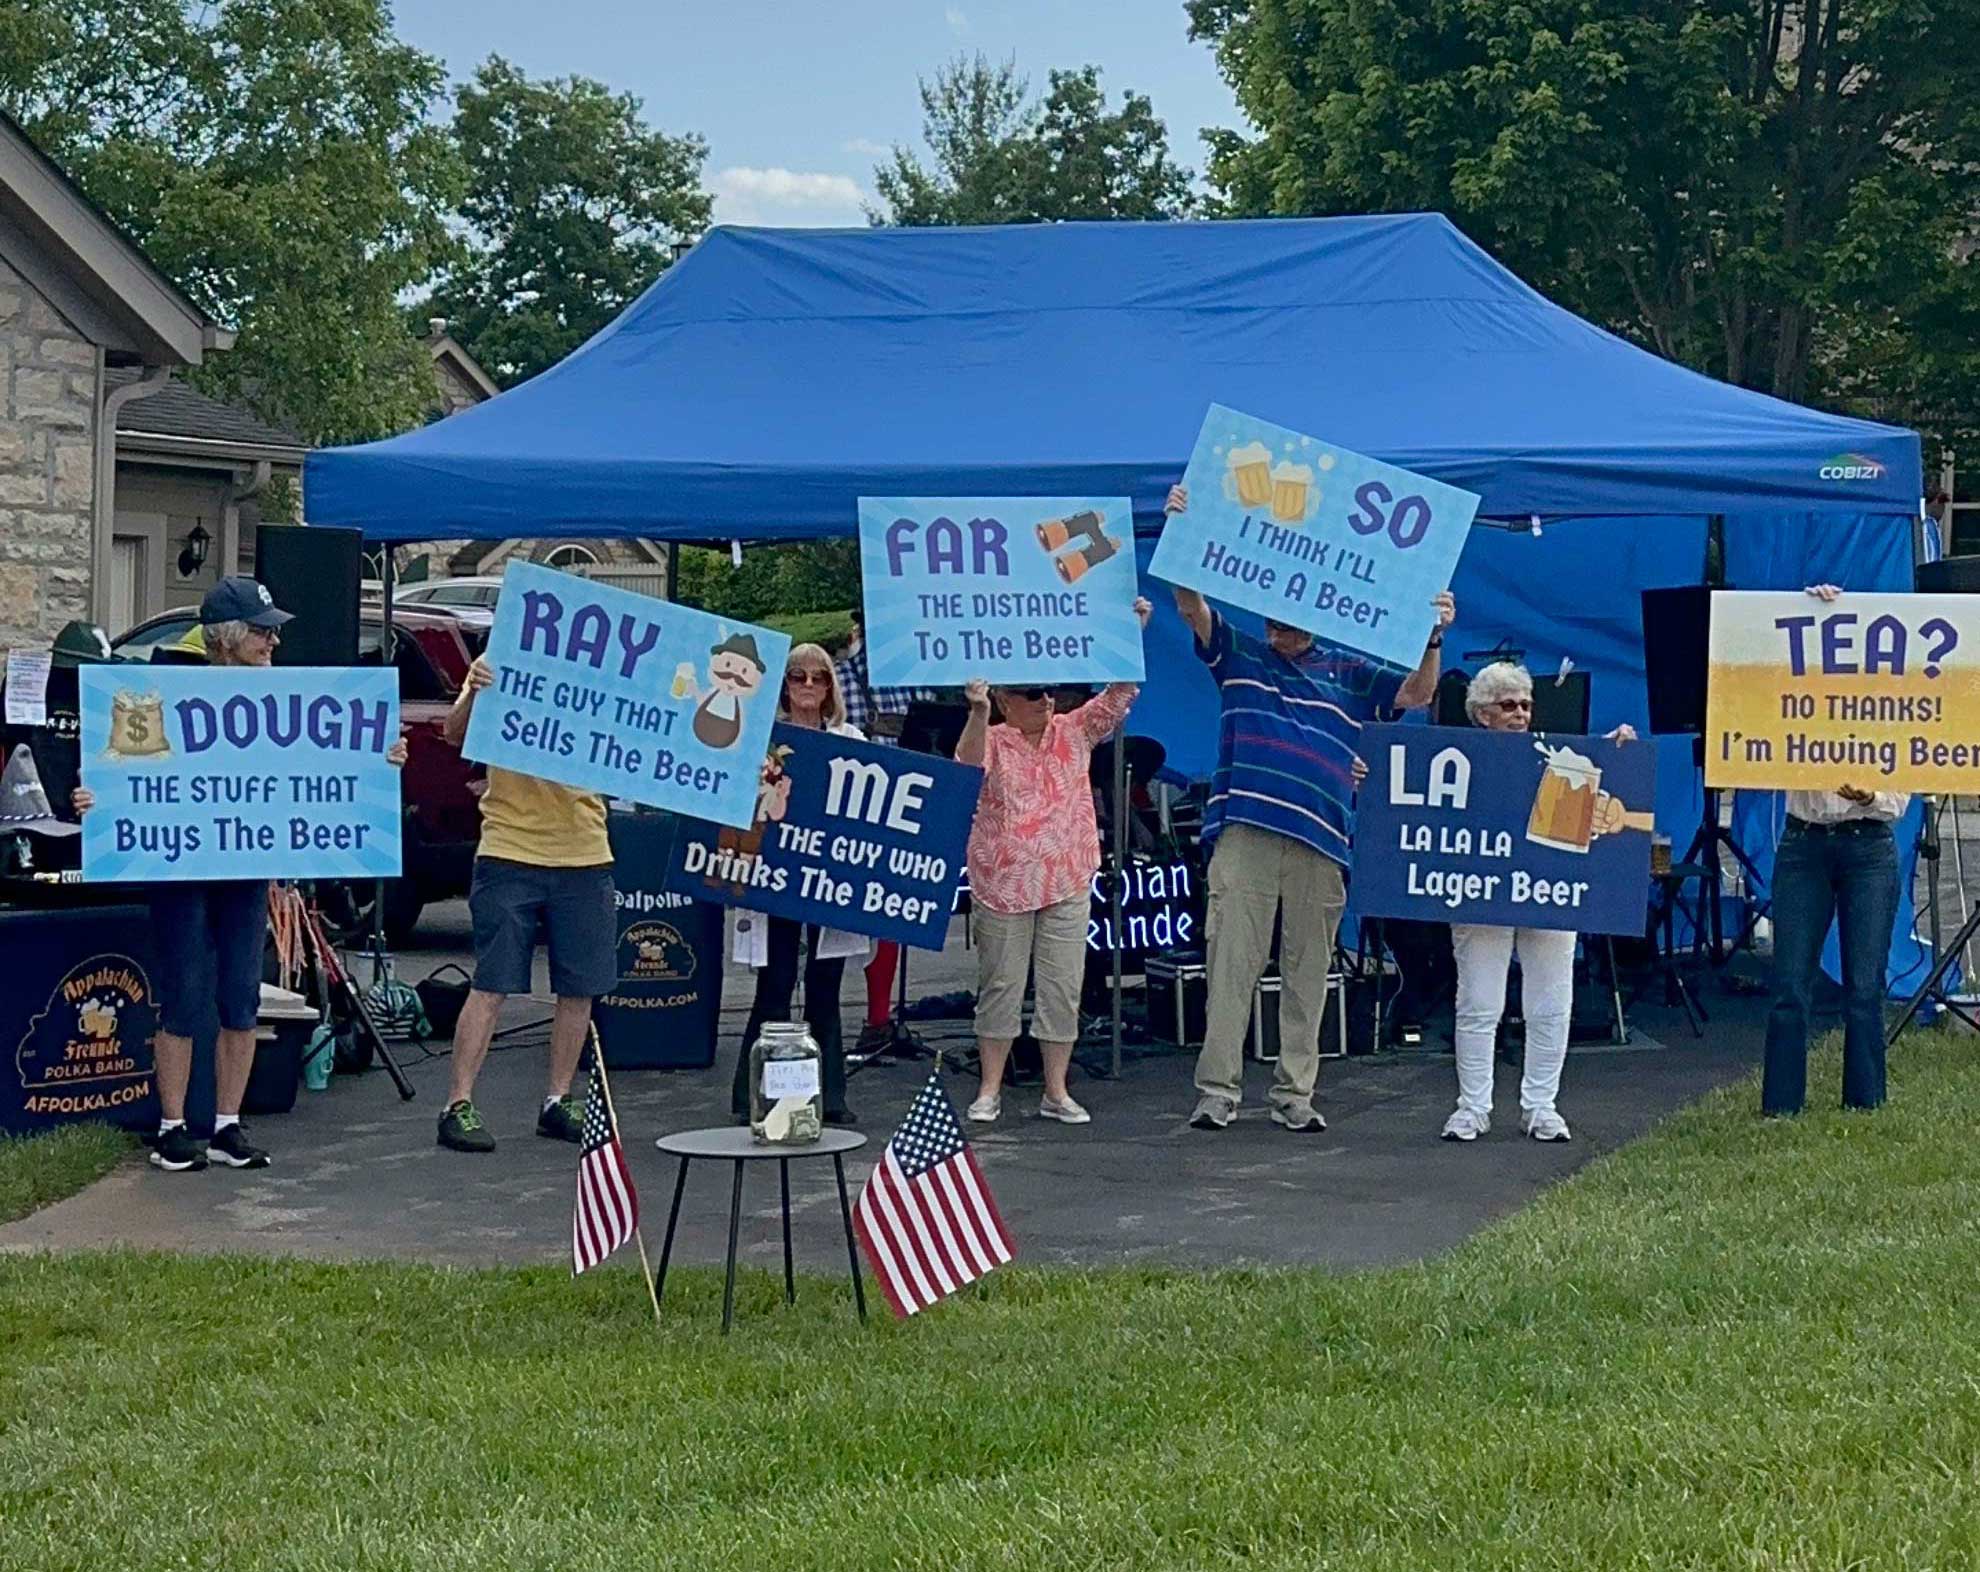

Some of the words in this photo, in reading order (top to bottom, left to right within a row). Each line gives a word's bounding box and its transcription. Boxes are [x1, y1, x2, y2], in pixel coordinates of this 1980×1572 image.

[1819, 465, 1879, 480] COBIZI
[1347, 481, 1432, 549] SO
[885, 516, 1010, 577] FAR
[1238, 515, 1251, 538] I
[1257, 520, 1331, 567] THINK
[1334, 548, 1377, 585] I'LL
[917, 594, 965, 618] THE
[971, 592, 1089, 619] DISTANCE
[1200, 540, 1276, 590] Have
[1284, 572, 1308, 602] A
[1313, 581, 1389, 629] Beer
[520, 589, 662, 680] RAY
[914, 631, 949, 661] To
[958, 629, 1013, 660] The
[1024, 629, 1095, 659] Beer
[1774, 613, 1959, 680] TEA?
[174, 693, 391, 755] DOUGH
[499, 665, 548, 704] THE
[553, 682, 606, 718] GUY
[613, 697, 679, 736] THAT
[1781, 693, 1816, 720] NO
[1824, 694, 1943, 722] THANKS!
[500, 710, 577, 757] Sells
[587, 730, 643, 774] The
[653, 749, 730, 795] Beer
[1721, 731, 1773, 762] I'm
[1785, 733, 1897, 776] Having
[1908, 736, 1980, 768] Beer
[127, 775, 181, 803] THE
[190, 775, 280, 803] STUFF
[289, 775, 359, 803] THAT
[824, 756, 935, 835] ME
[1389, 744, 1472, 809] LA
[115, 819, 202, 863] Buys
[213, 816, 276, 852] The
[288, 818, 371, 851] Beer
[778, 822, 824, 858] THE
[830, 835, 885, 870] GUY
[888, 851, 948, 883] WHO
[1400, 823, 1433, 851] LA
[1439, 826, 1472, 855] LA
[1478, 829, 1513, 858] LA
[683, 841, 789, 893] Drinks
[800, 866, 855, 907] The
[862, 882, 939, 924] Beer
[1407, 863, 1501, 908] Lager
[1510, 870, 1590, 907] Beer
[1086, 904, 1193, 950] eunde
[600, 991, 699, 1009] AFPOLKA.COM
[44, 1063, 91, 1080] POLKA
[96, 1058, 135, 1074] BAND
[63, 1037, 122, 1061] Freunde
[24, 1081, 150, 1113] AFPOLKA.COM
